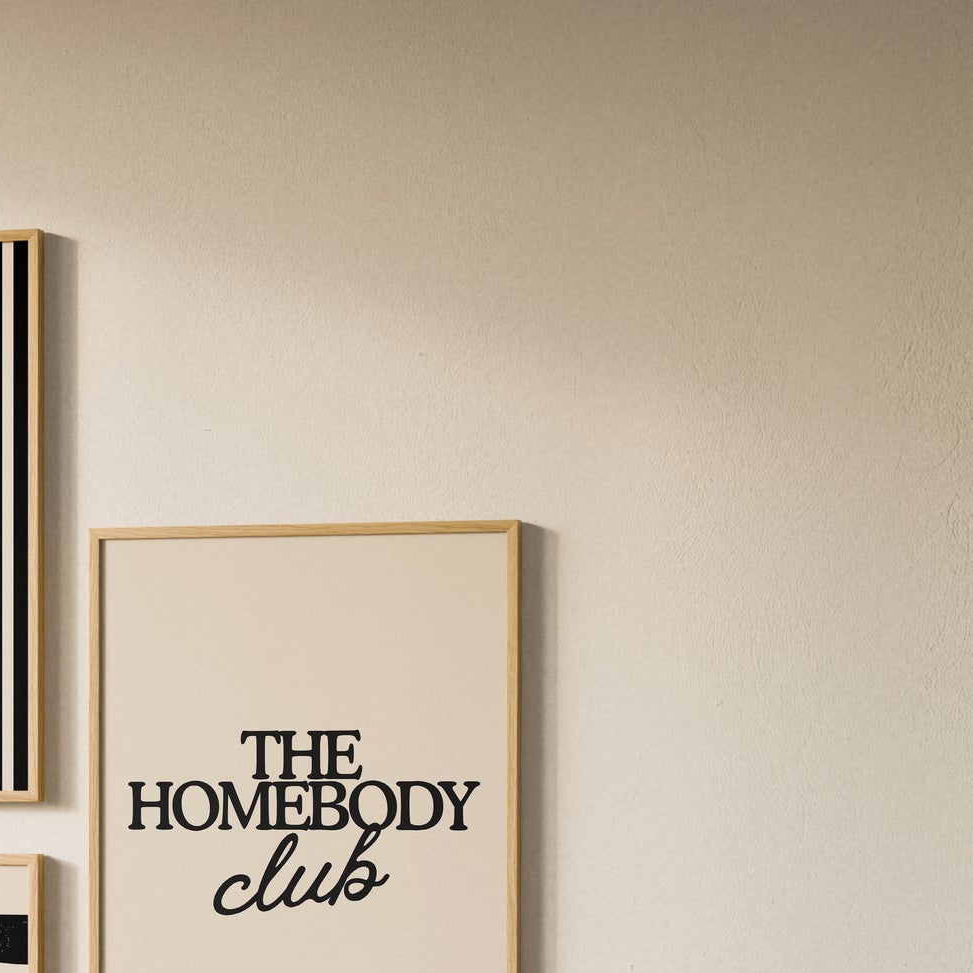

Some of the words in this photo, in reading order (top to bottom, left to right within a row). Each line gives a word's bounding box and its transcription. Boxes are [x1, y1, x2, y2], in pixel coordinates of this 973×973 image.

[240, 729, 363, 781] THE
[127, 780, 481, 832] HOMEBODY
[212, 822, 390, 916] club
